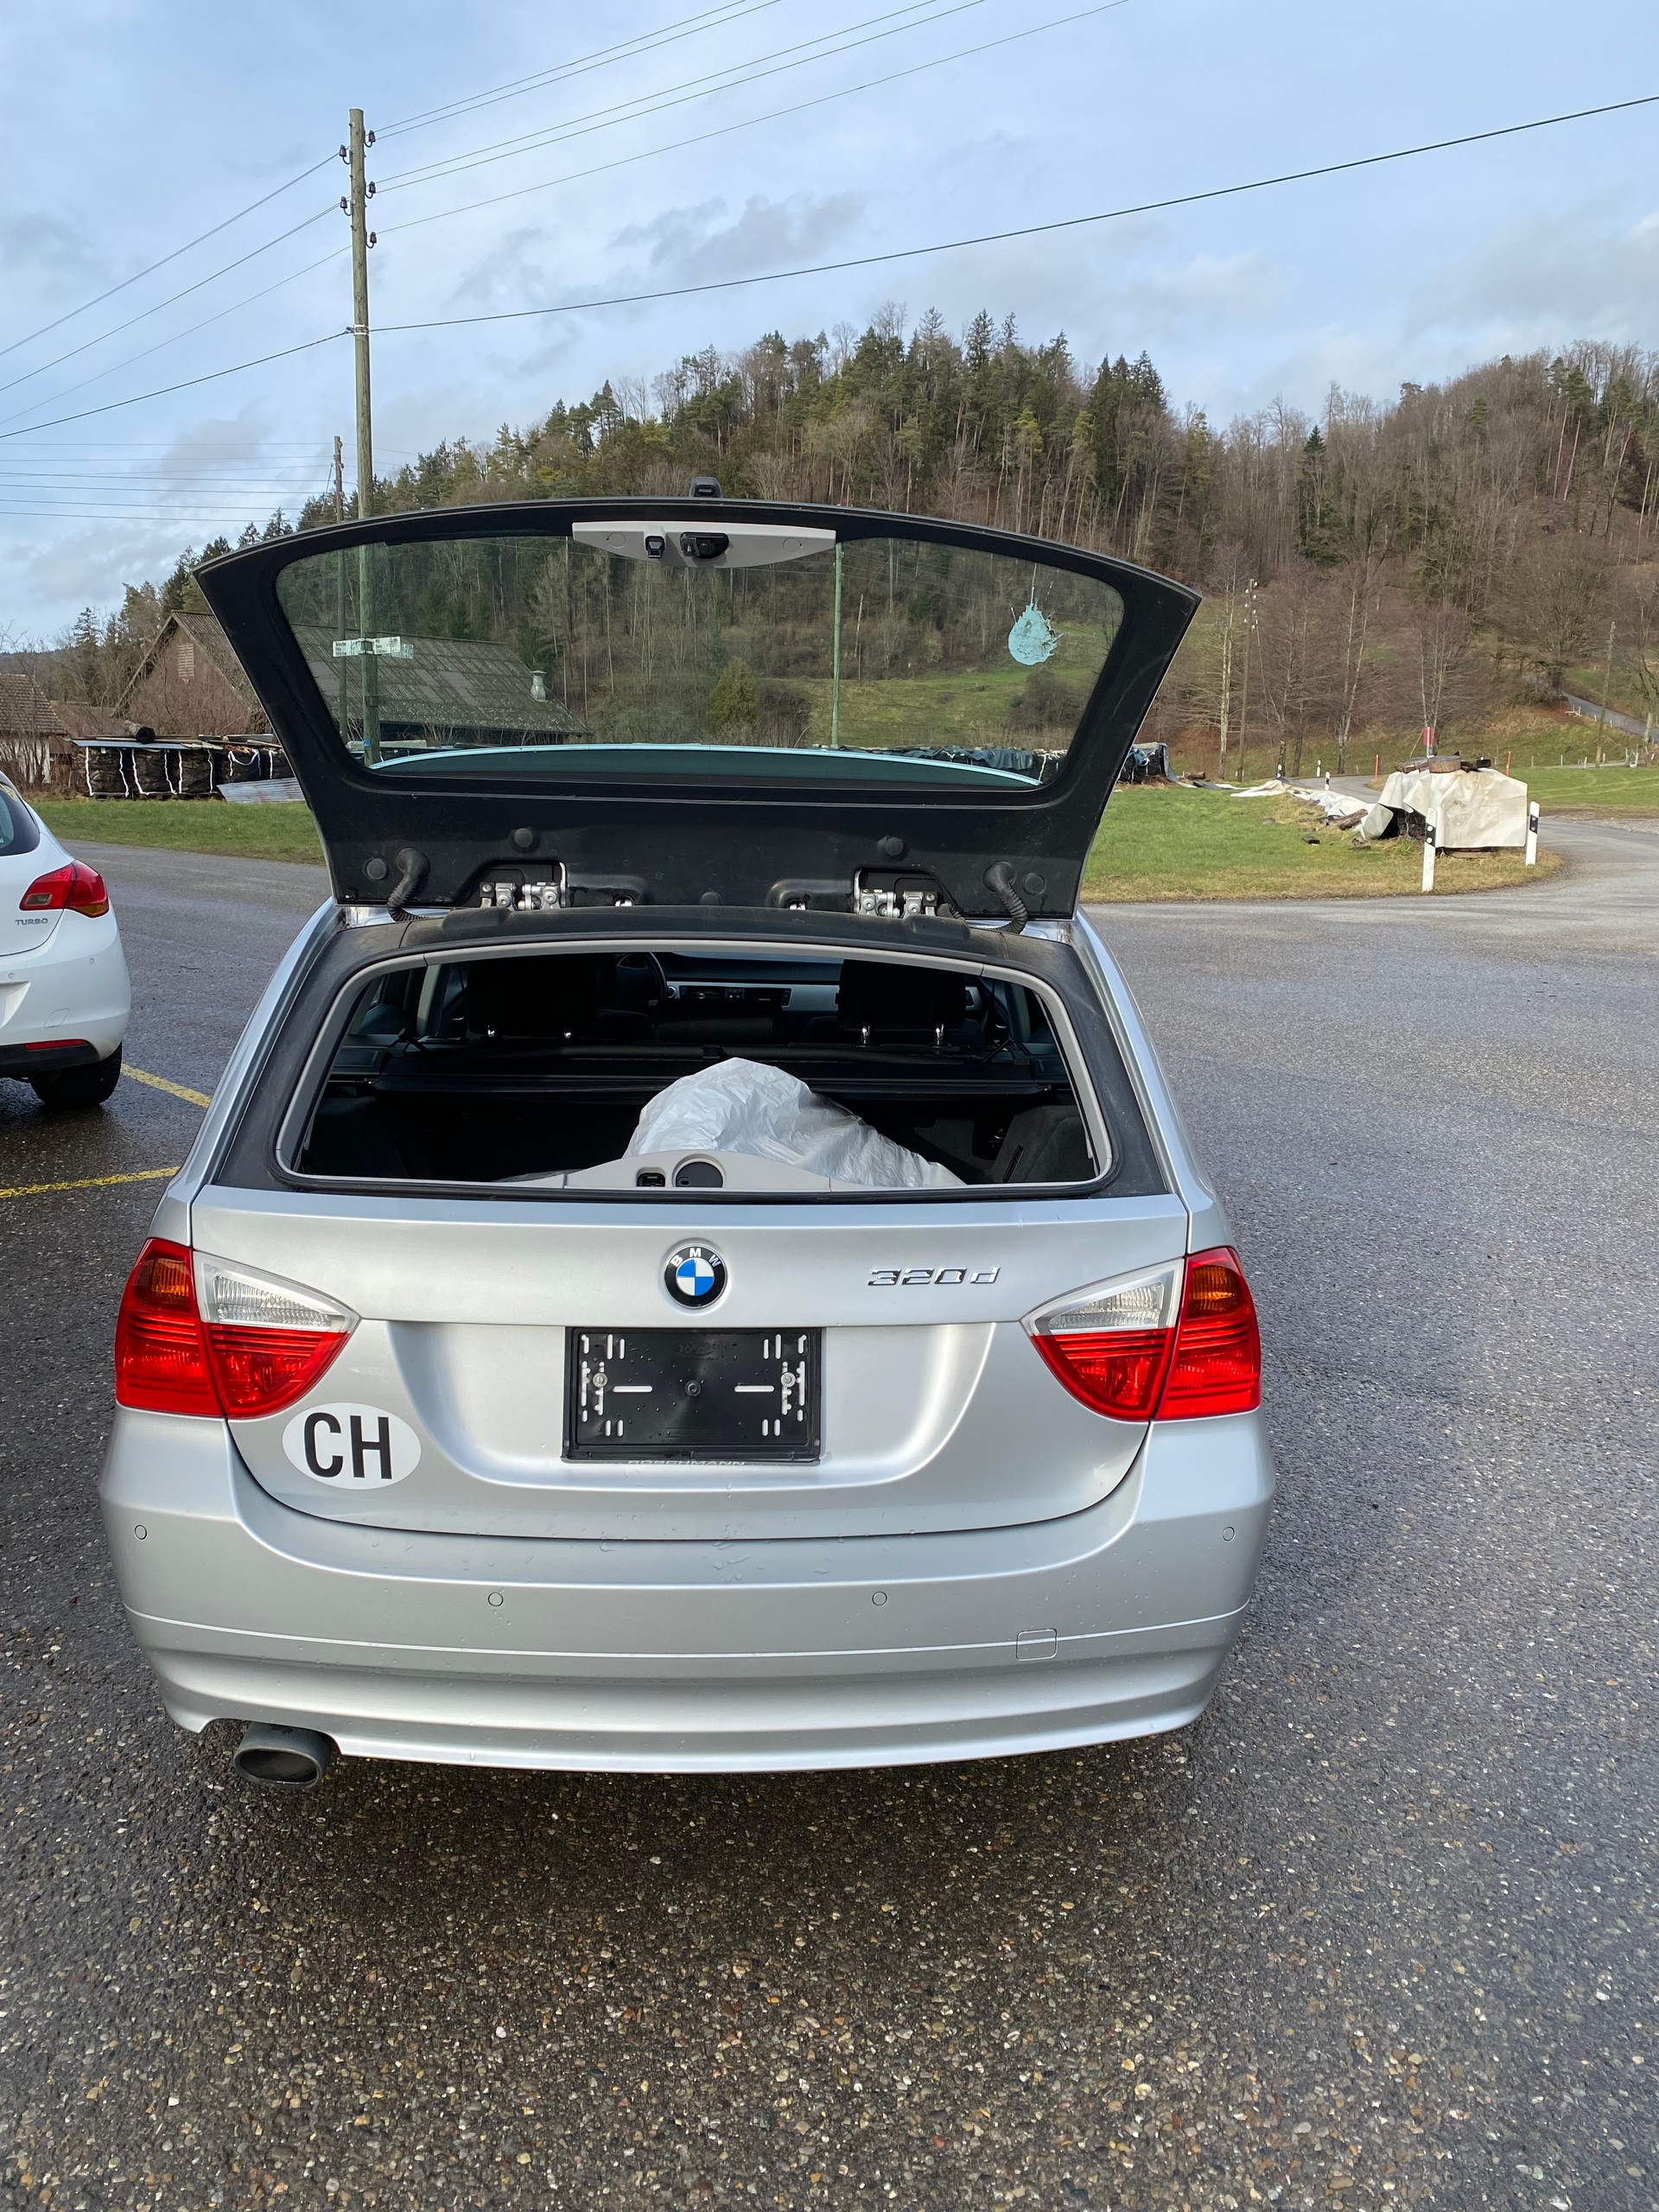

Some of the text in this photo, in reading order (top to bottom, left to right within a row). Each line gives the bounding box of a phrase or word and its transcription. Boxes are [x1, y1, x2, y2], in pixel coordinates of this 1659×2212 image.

[670, 1247, 721, 1268] BMW
[867, 1265, 1001, 1286] 320d
[303, 1412, 392, 1479] CH
